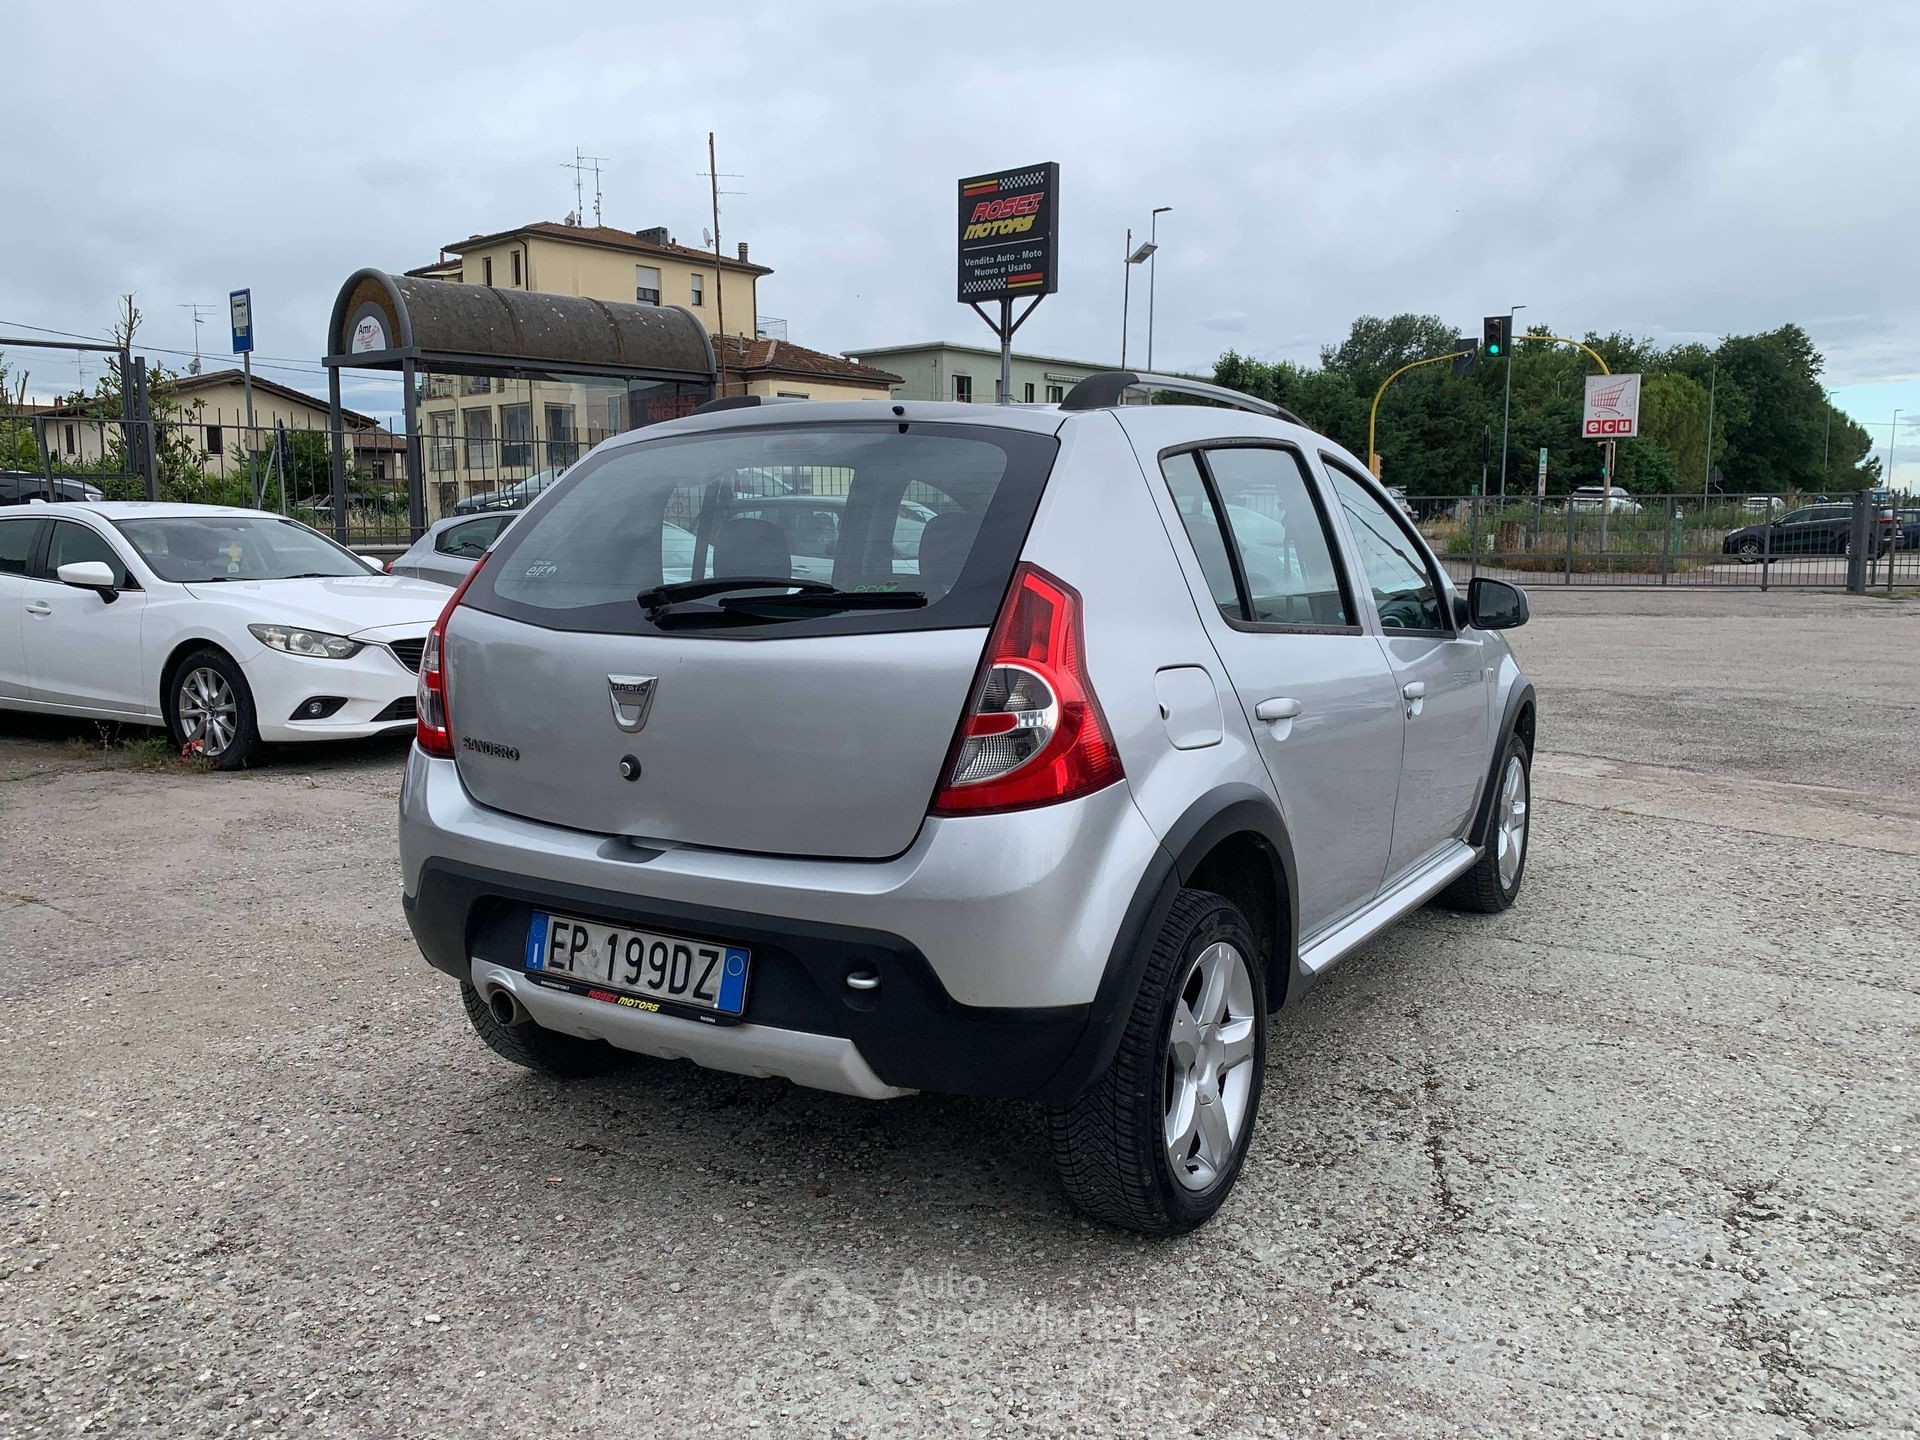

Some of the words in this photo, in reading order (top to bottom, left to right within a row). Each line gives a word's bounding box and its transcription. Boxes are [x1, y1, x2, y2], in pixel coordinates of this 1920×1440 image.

[970, 192, 1044, 222] ROSEI
[963, 214, 1036, 240] MOTORS
[964, 256, 994, 267] Vendita
[996, 253, 1015, 262] Auto
[1022, 249, 1043, 259] Moto
[974, 267, 998, 277] Nuovo
[1008, 262, 1032, 272] Usato
[611, 683, 645, 694] DACIA
[463, 736, 520, 761] SANDERO
[548, 921, 589, 971] EP
[607, 933, 719, 1001] 199DZ
[617, 996, 661, 1013] MOTORS
